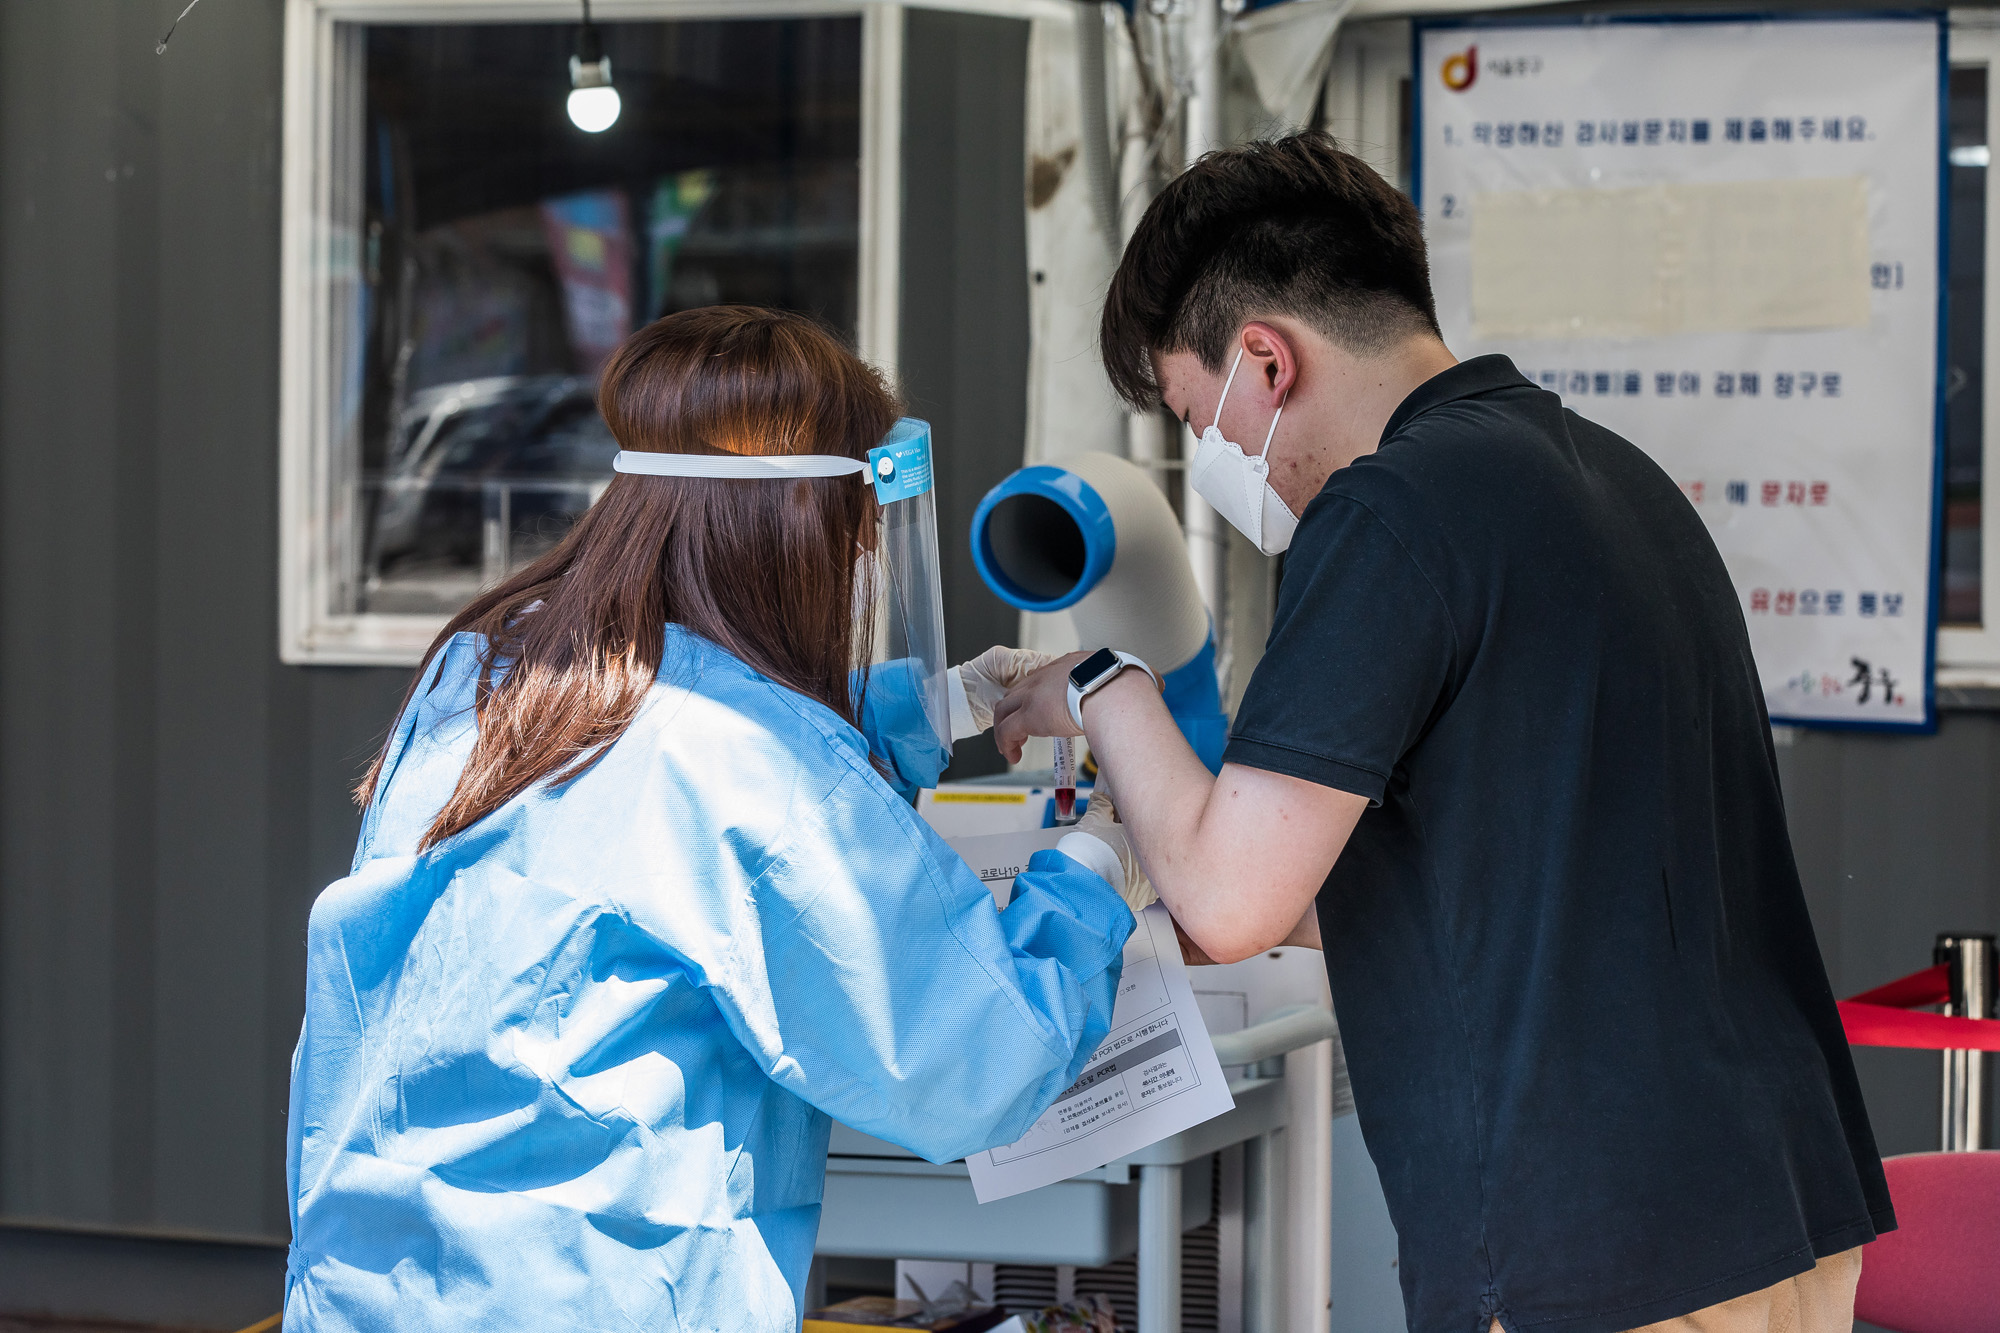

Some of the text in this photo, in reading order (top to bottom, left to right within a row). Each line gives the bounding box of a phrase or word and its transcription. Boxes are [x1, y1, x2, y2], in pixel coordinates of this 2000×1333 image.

[1473, 121, 1564, 148] 작성하신
[1576, 118, 1711, 147] 검사설문지를
[1724, 115, 1876, 144] 제출해주세요.
[1654, 371, 1700, 398] 받아
[1774, 372, 1842, 399] 창구로
[1760, 480, 1829, 508] 문자로
[1750, 587, 1904, 618] 유선으로 통보
[980, 866, 1020, 879] 코로나19
[1098, 1046, 1113, 1058] PCR
[1113, 1036, 1134, 1050] 법으로
[1135, 1018, 1169, 1038] 시행합니다
[1096, 1063, 1117, 1079] PCR법
